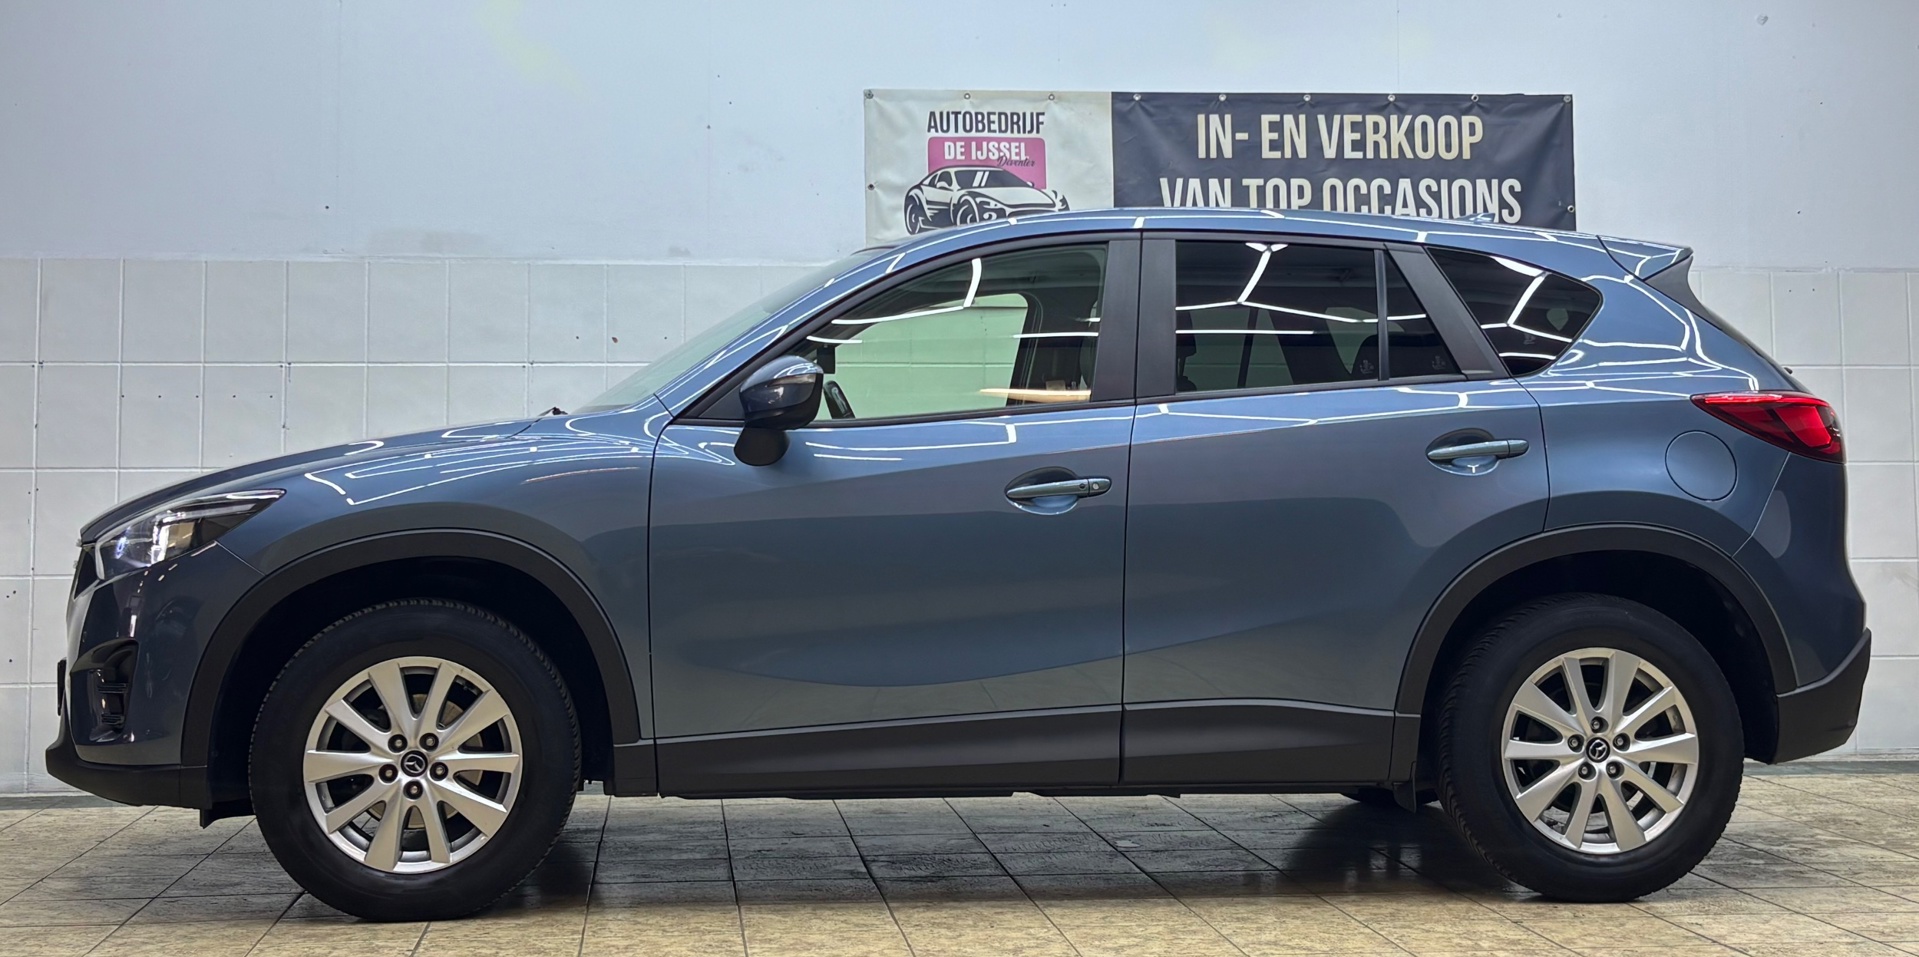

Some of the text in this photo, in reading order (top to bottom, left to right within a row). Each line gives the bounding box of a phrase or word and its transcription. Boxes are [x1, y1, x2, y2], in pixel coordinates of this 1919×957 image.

[927, 111, 1046, 135] AUTOBEDRIJF
[1197, 113, 1484, 160] IN- EN VERKOOP
[944, 141, 1030, 161] DE IJSSEL
[1159, 177, 1522, 224] VAN TOP OCCASIONS
